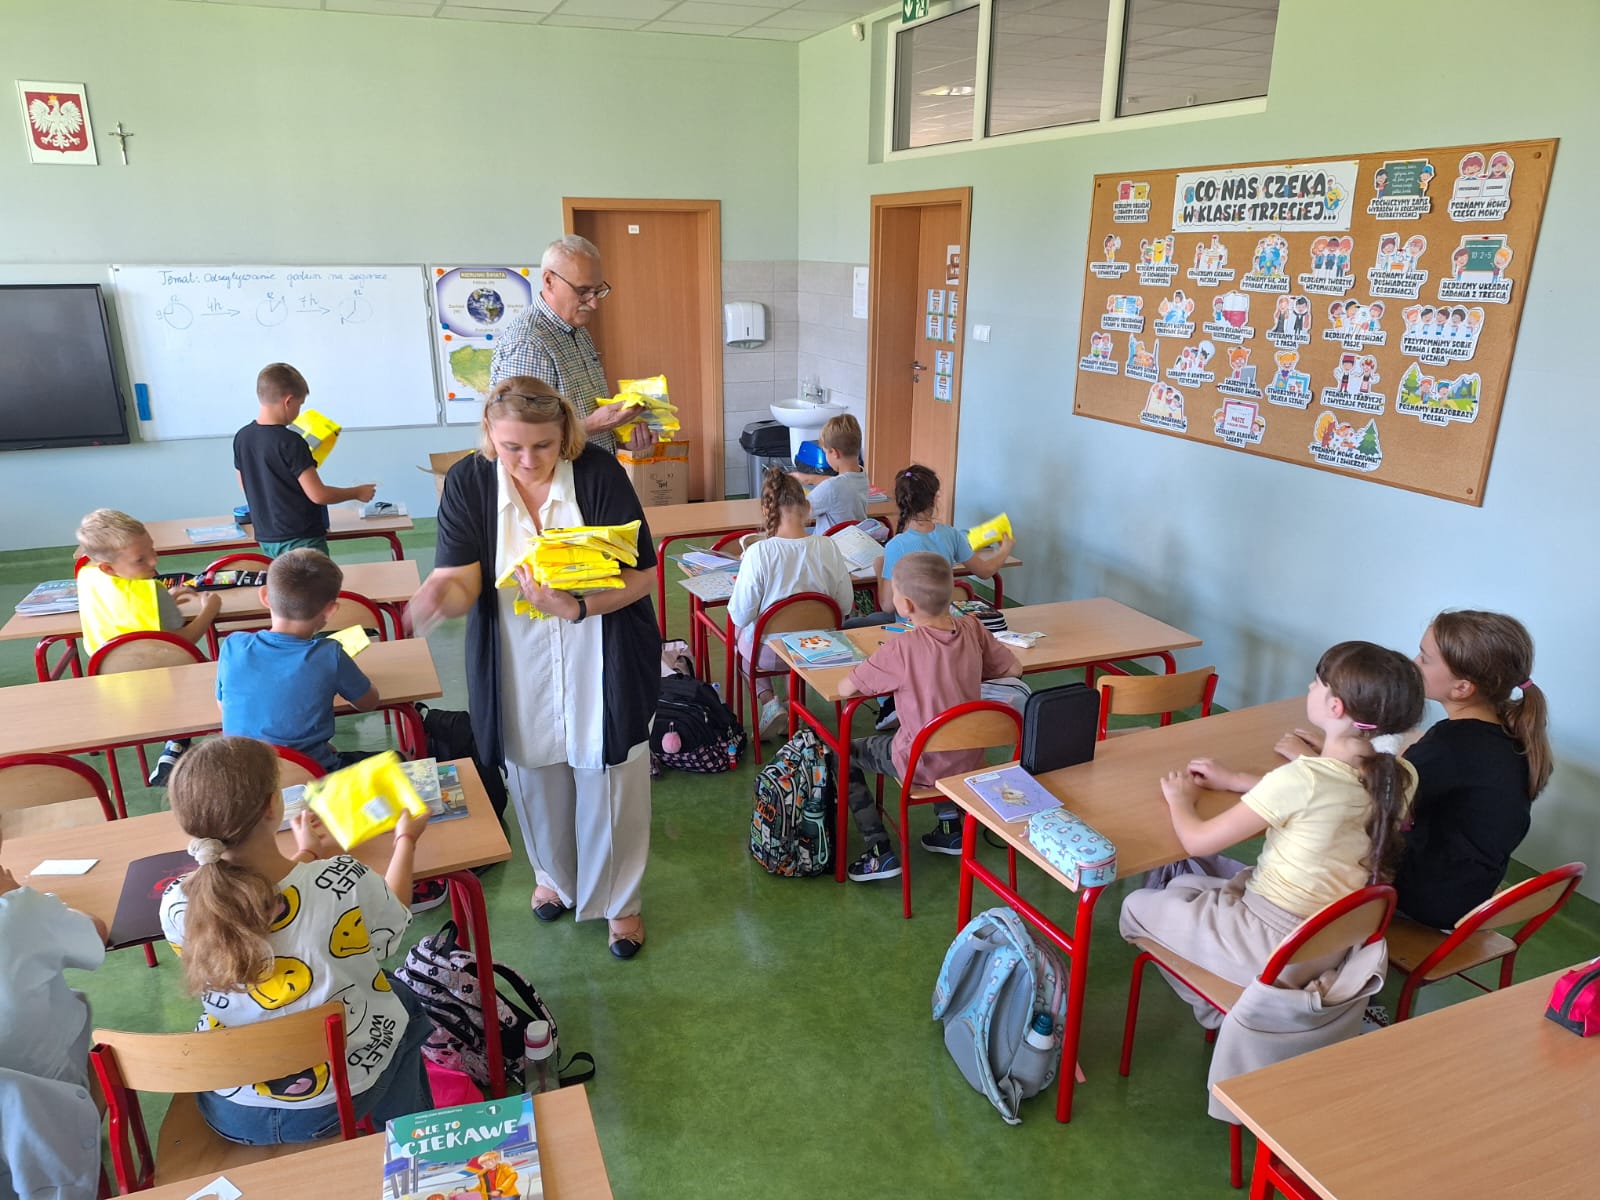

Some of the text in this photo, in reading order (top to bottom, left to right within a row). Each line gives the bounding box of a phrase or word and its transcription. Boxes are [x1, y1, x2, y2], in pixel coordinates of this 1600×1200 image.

[1194, 173, 1326, 202] CO NAS CZEKA
[1451, 200, 1507, 209] POZNAMY NOWE
[1183, 206, 1194, 223] W
[1370, 271, 1424, 281] WYKONAMY WIELE
[1442, 282, 1478, 290] BĘDZIEMY
[1441, 290, 1471, 298] ZADANIA
[1268, 332, 1292, 340] SPOTKAMY
[1325, 332, 1353, 340] BĘDZIEMY
[1404, 338, 1450, 347] PRZYPOMNIMY
[1325, 391, 1352, 399] POZNAMY
[1328, 398, 1356, 407] ZWYCZAJE
[1399, 403, 1473, 418] POZNAMY KRAJOBRAZY
[1311, 445, 1336, 455] POZNAMY
[1337, 451, 1353, 459] NOWE
[314, 856, 354, 890] ORLD
[331, 861, 369, 901] MILEY
[347, 1014, 385, 1067] WORLD
[360, 1018, 396, 1075] SMILEY
[412, 1120, 461, 1139] ALE TO
[401, 1119, 518, 1158] CIEKAWE
